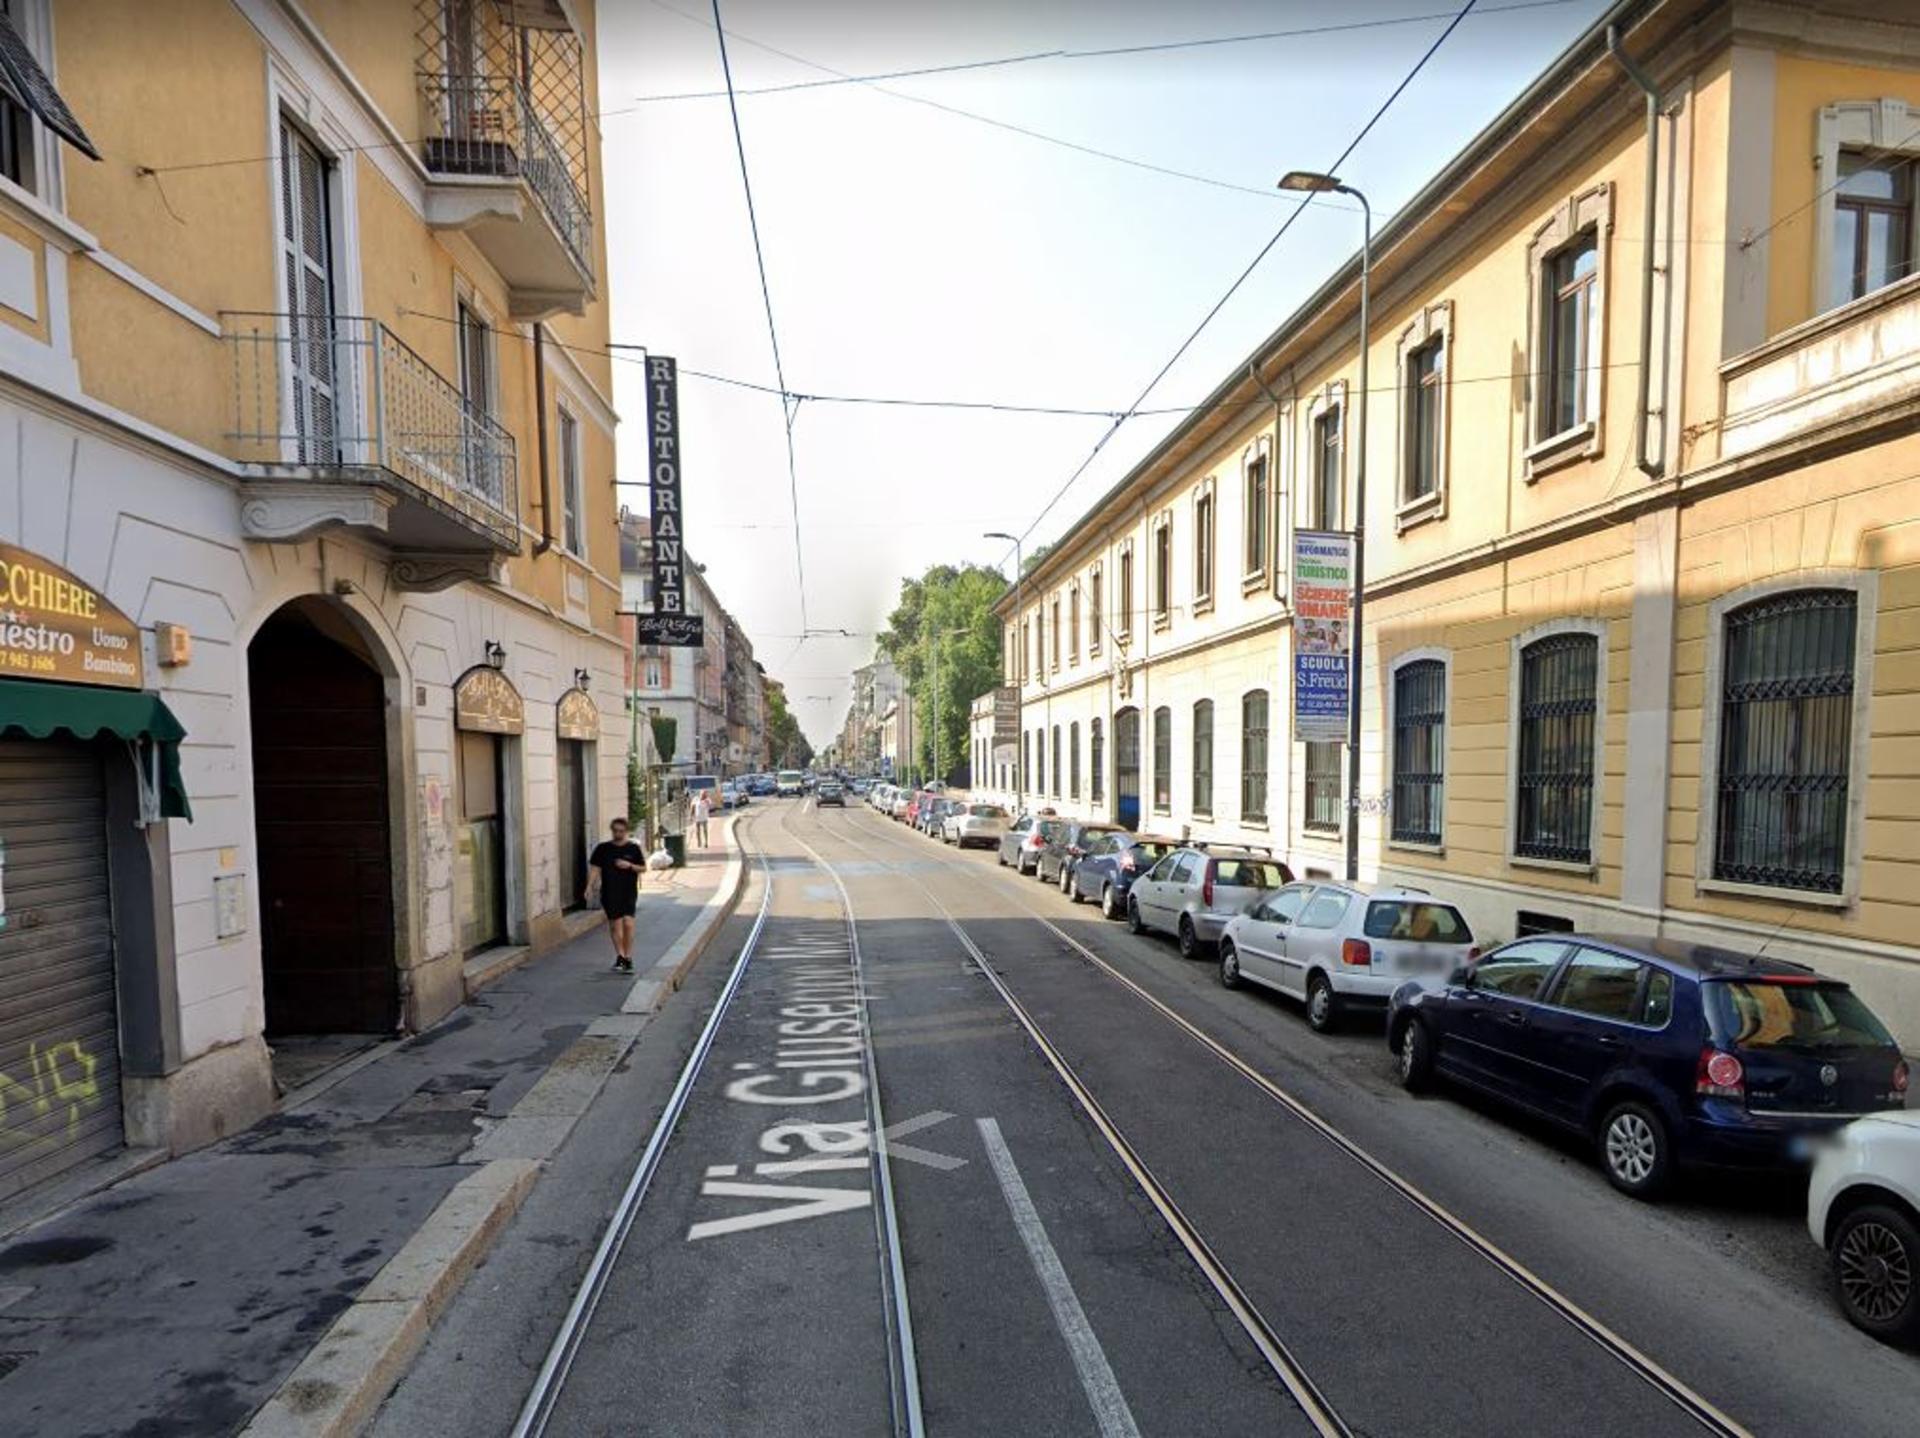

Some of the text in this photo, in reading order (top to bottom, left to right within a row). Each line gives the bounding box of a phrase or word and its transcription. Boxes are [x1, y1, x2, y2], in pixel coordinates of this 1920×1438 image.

[650, 358, 681, 613] RISTORANTE
[1297, 565, 1348, 580] TURISTICO
[1296, 586, 1348, 602] SCIENZE
[1296, 601, 1348, 619] UMANE
[92, 626, 128, 650] Uomo
[1301, 656, 1345, 671] SCUOLA
[1297, 671, 1347, 690] S.Freud
